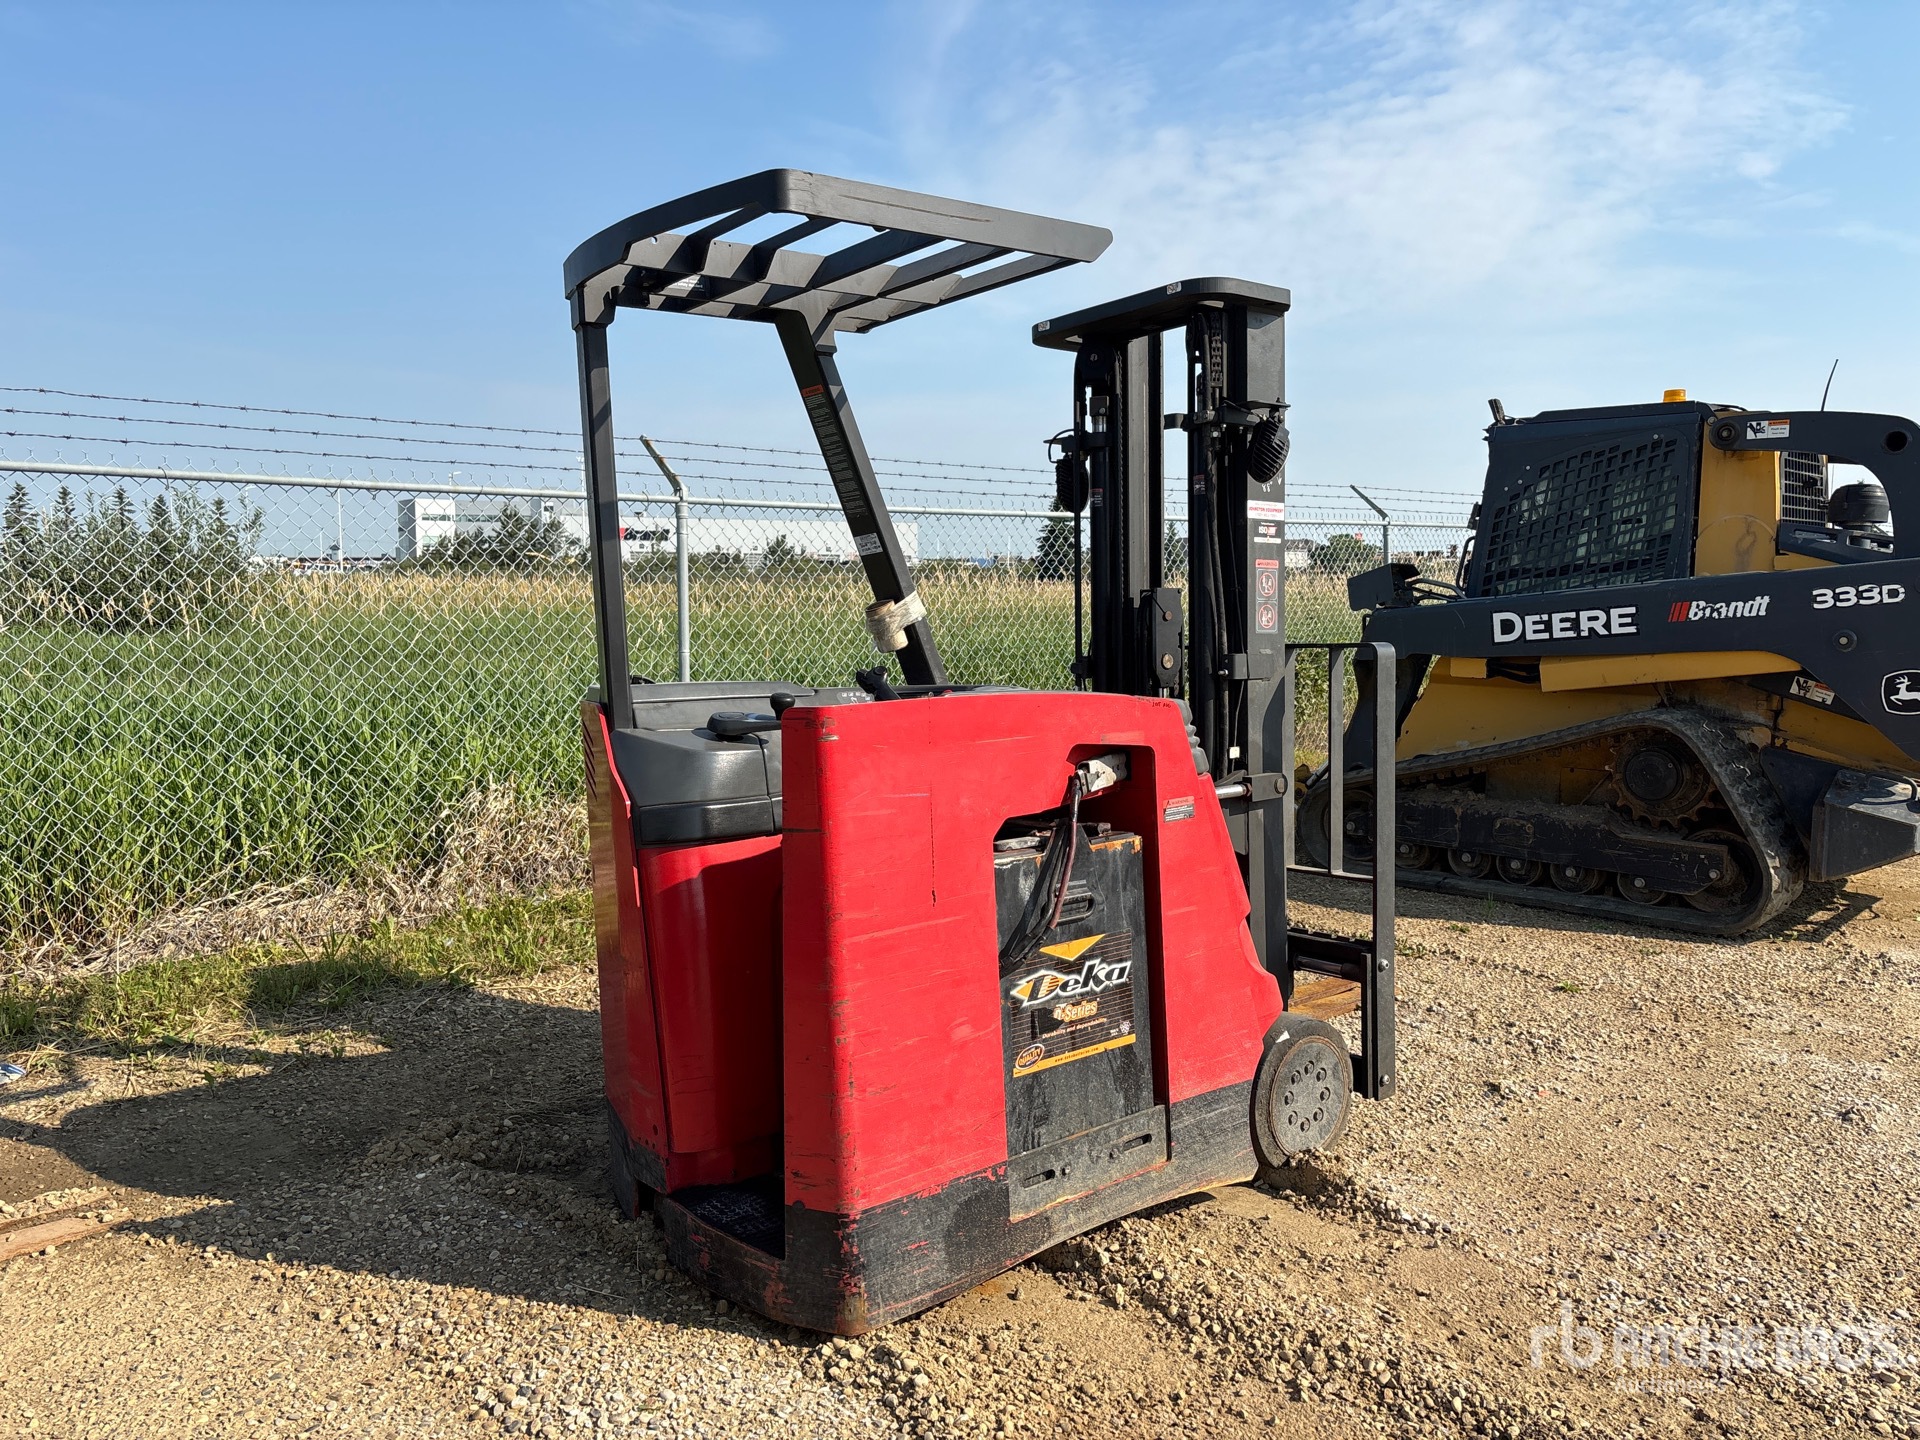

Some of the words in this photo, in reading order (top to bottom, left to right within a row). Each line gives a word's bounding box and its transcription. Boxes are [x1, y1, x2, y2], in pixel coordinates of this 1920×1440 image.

[1688, 595, 1770, 621] Brandt
[1812, 584, 1906, 609] 333D
[1493, 606, 1638, 643] DEERE
[1017, 959, 1131, 1006] Deka
[1018, 1047, 1041, 1066] QUALITY
